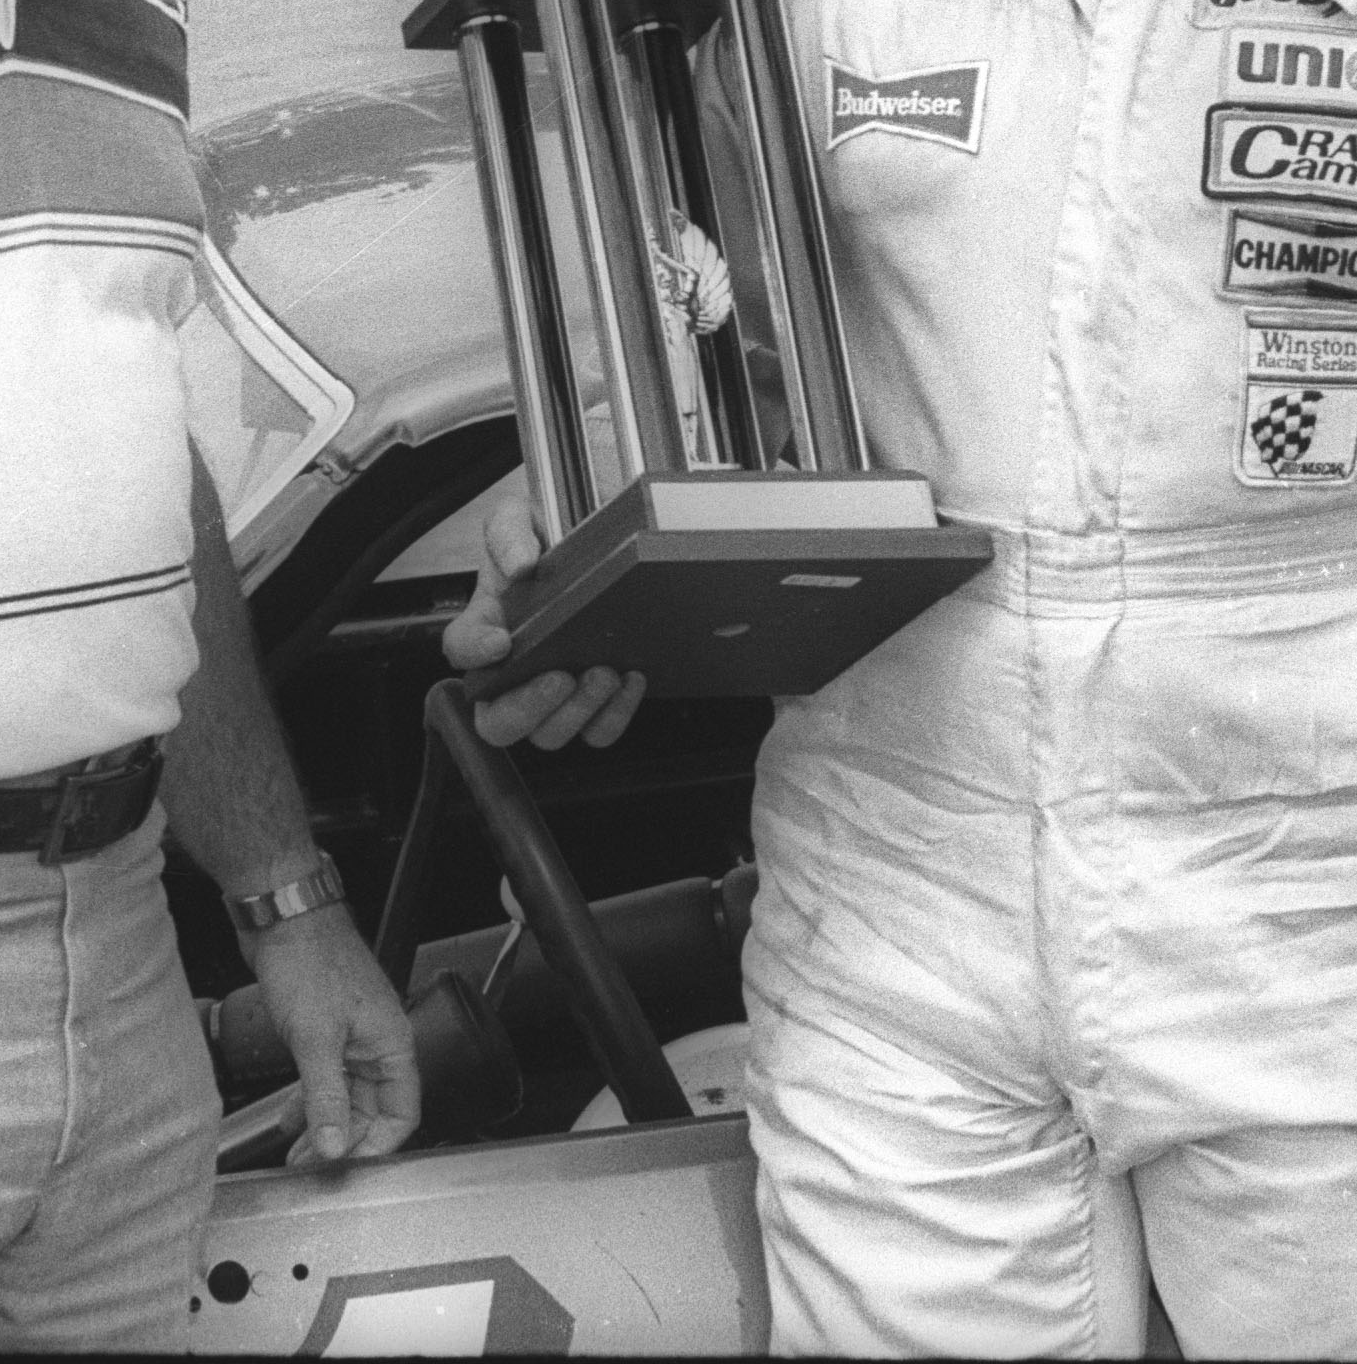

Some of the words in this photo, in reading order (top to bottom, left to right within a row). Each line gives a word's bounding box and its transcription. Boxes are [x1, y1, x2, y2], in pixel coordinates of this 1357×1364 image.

[836, 87, 962, 116] Budweiser
[1261, 330, 1357, 356] Winston
[1257, 352, 1307, 373] Racing
[1311, 354, 1357, 373] Series
